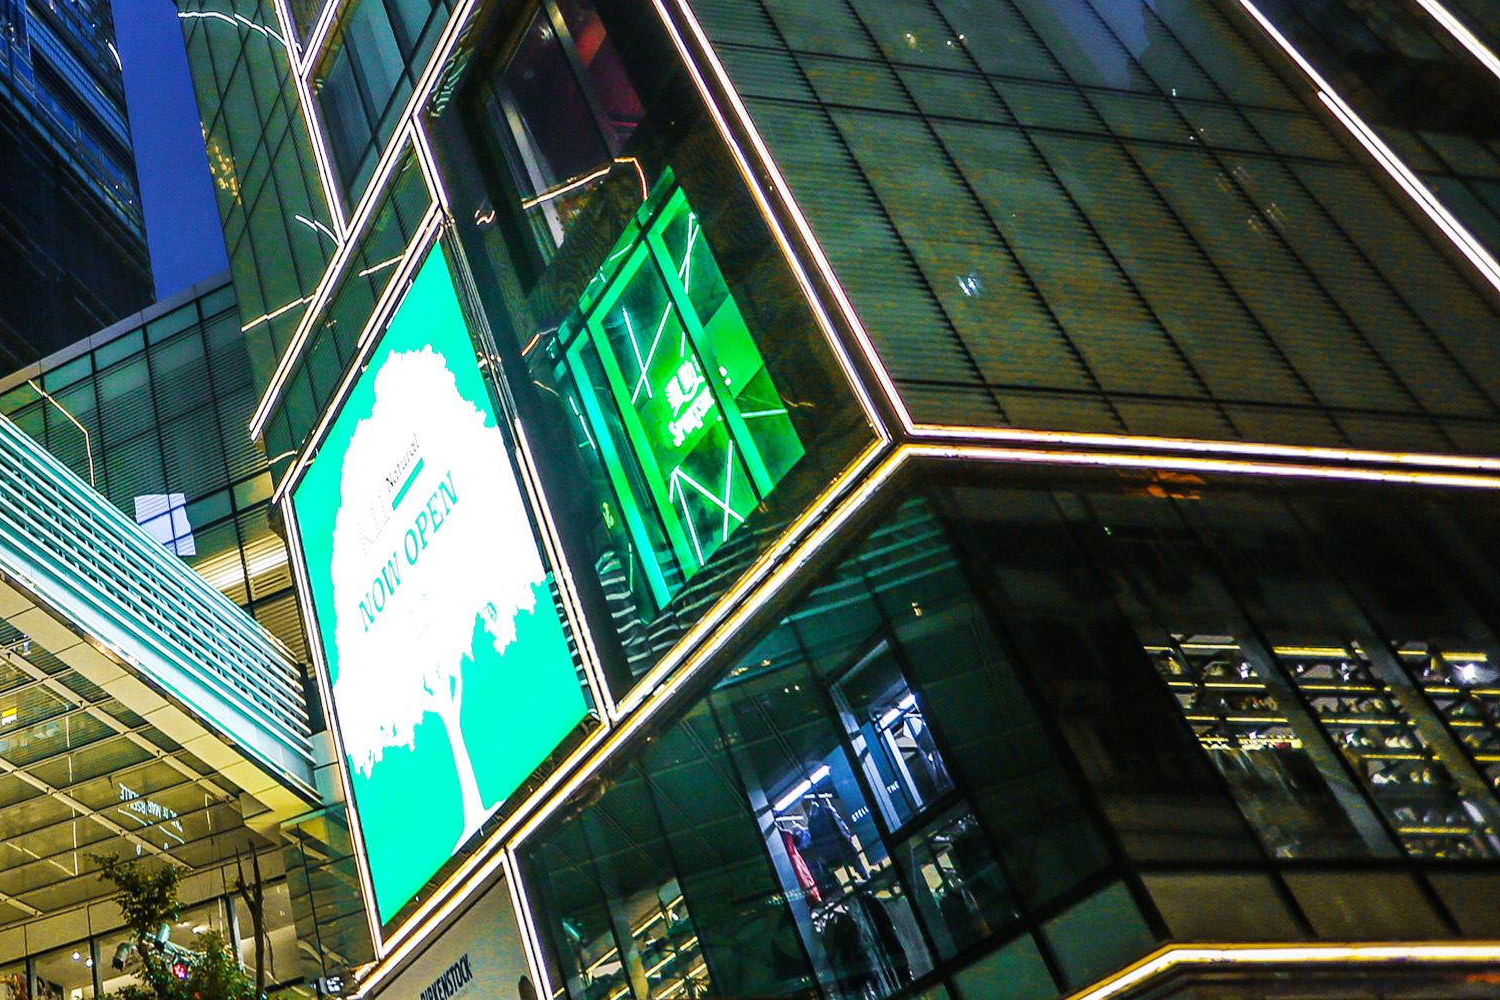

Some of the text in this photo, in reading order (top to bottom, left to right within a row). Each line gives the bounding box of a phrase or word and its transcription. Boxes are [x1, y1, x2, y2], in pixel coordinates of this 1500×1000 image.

[386, 432, 420, 493] Natural
[358, 469, 458, 634] NOW OPEN
